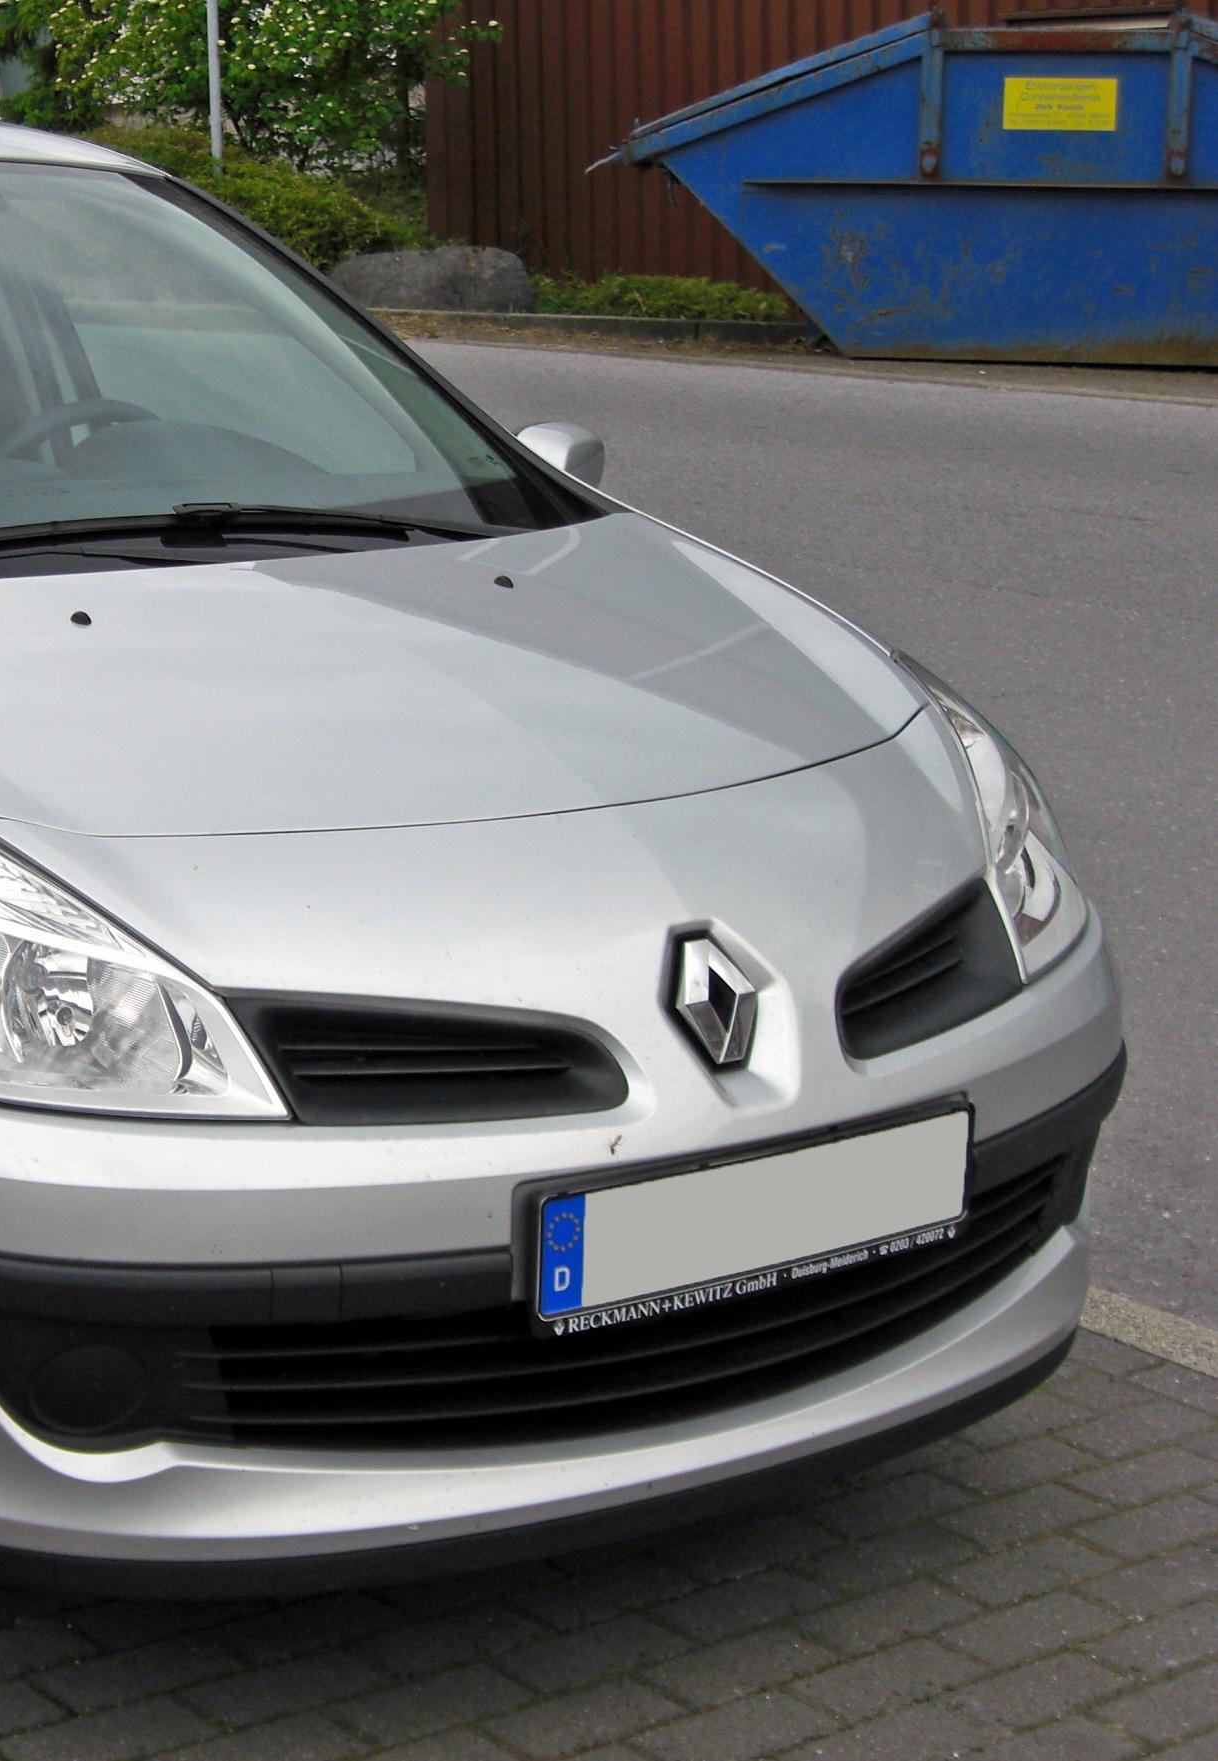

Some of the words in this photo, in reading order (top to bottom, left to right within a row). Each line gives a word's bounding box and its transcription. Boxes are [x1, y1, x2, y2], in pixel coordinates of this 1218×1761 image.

[554, 1266, 570, 1292] D
[735, 1272, 777, 1295] GmbH
[791, 1249, 869, 1279] Duisburg-Meiderich
[889, 1237, 910, 1253] 0203
